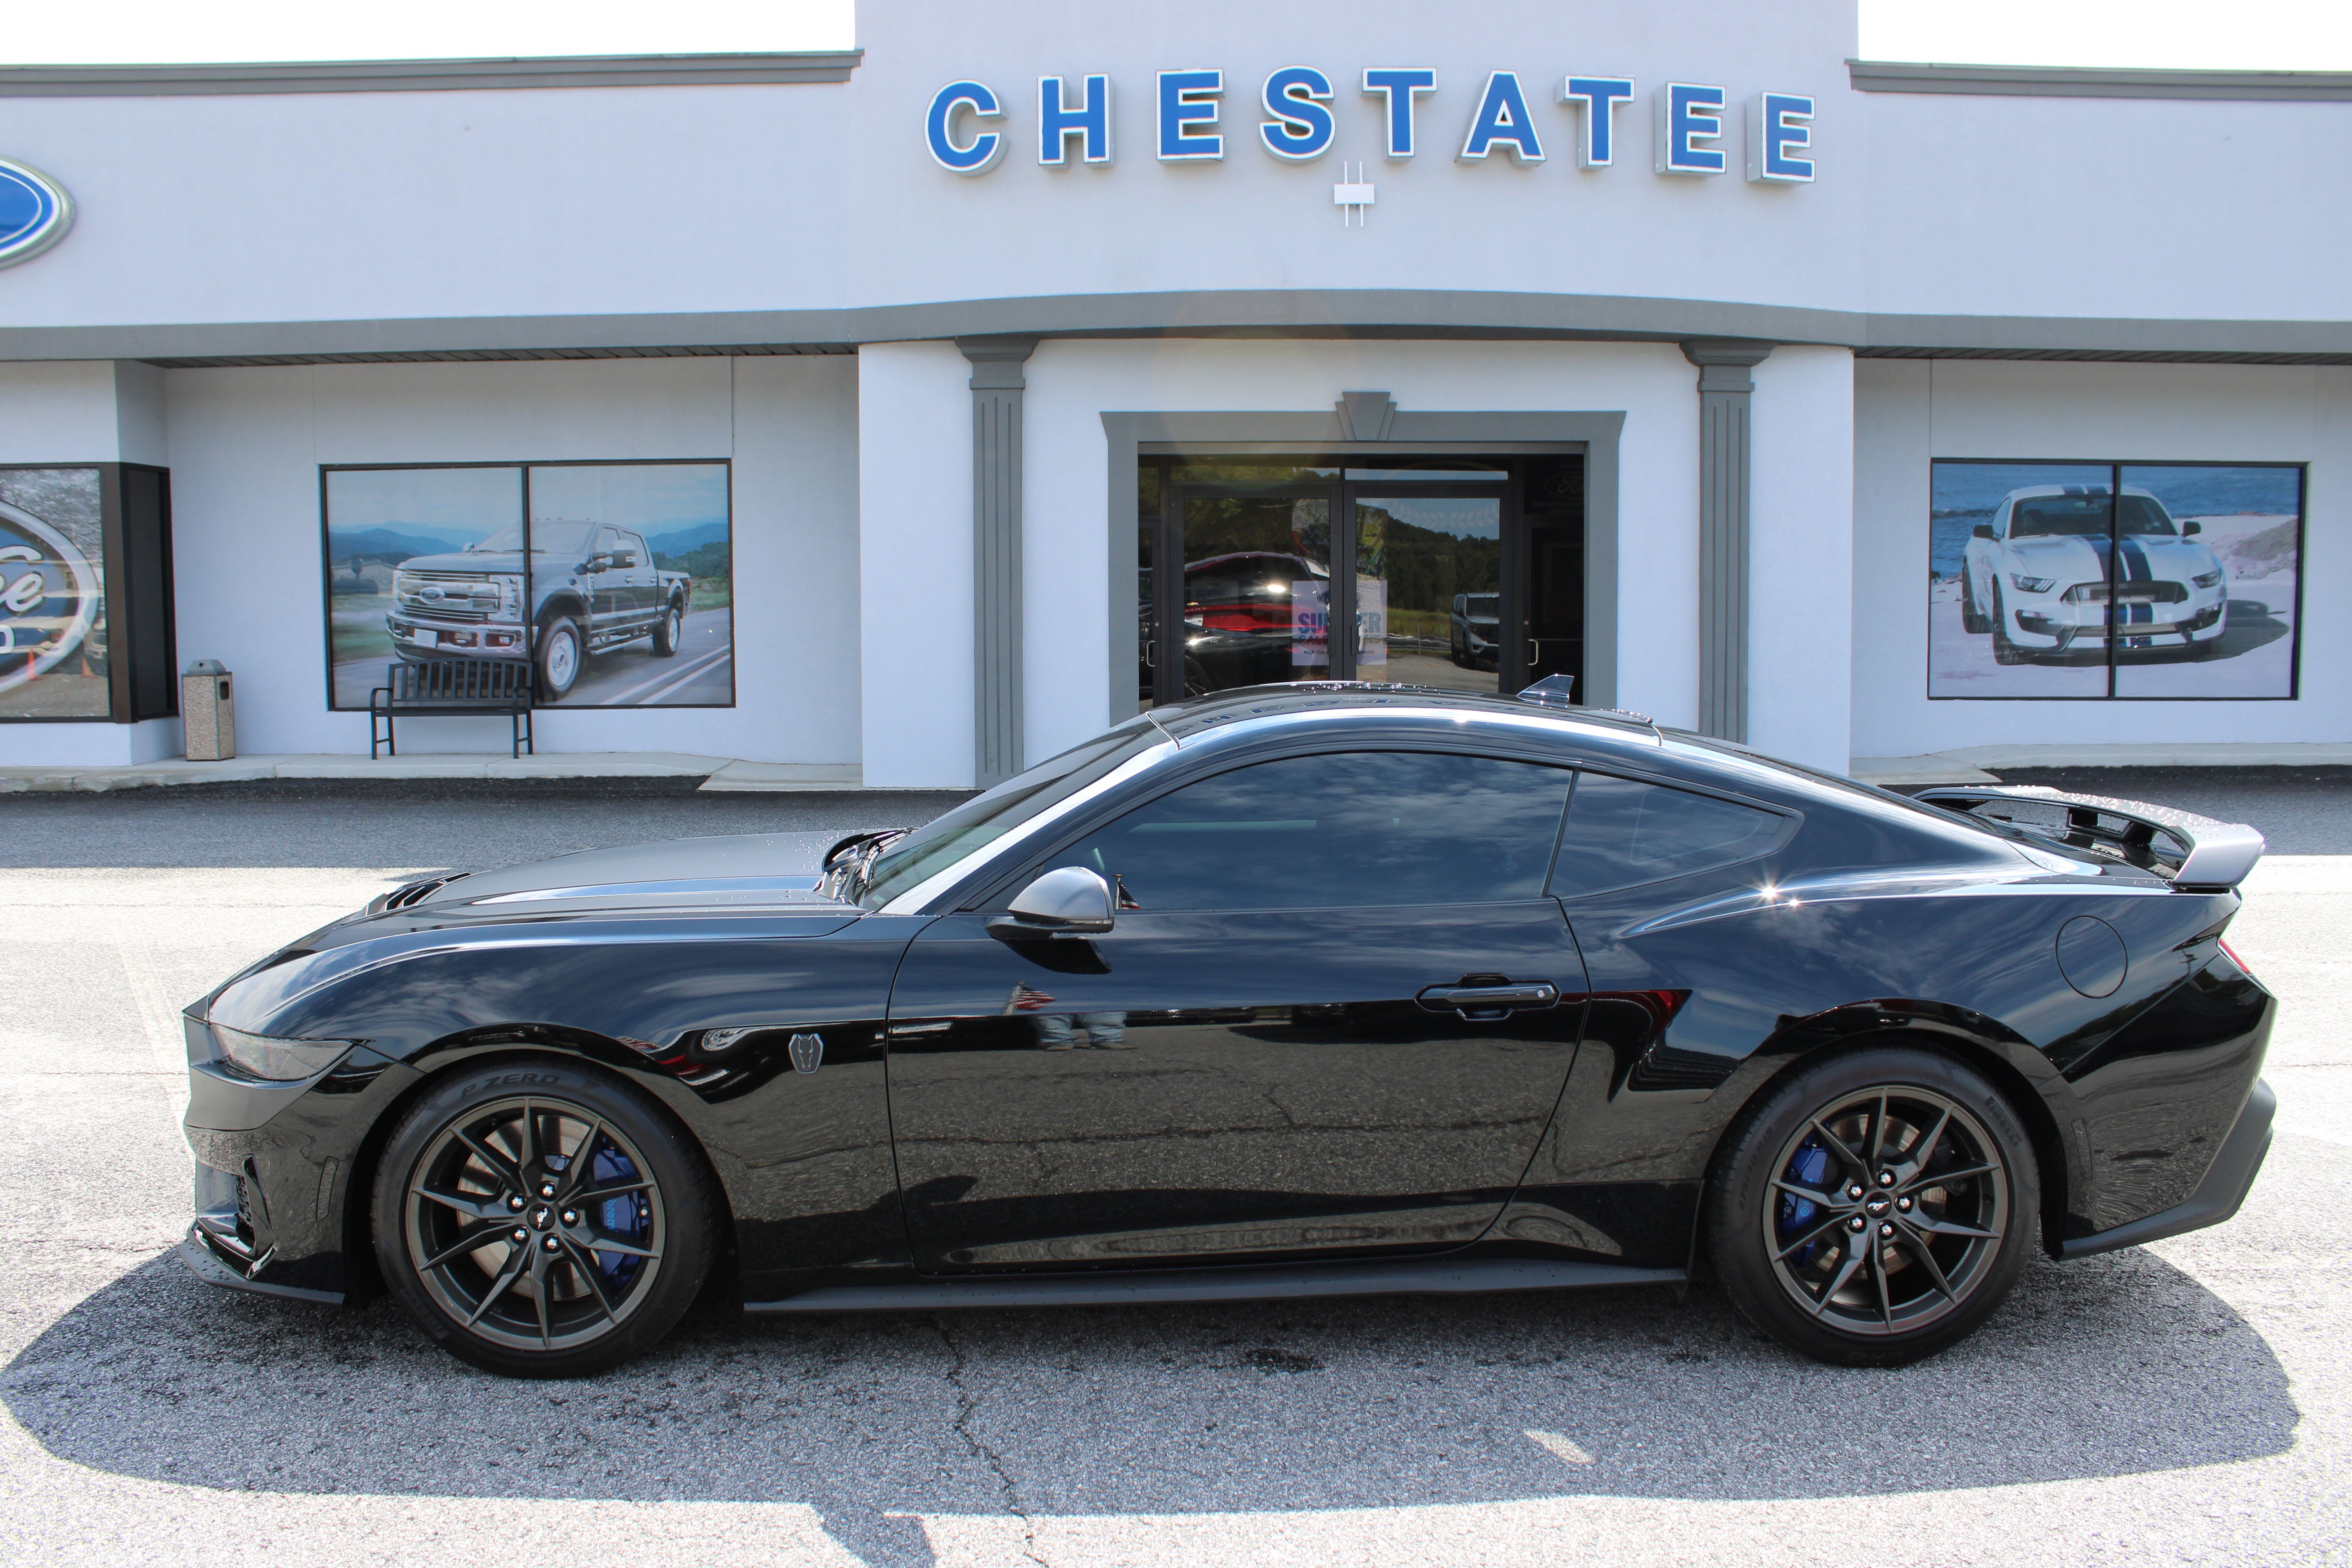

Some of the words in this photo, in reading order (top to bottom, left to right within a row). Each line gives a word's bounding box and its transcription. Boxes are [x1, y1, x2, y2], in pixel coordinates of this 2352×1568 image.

[924, 65, 1816, 185] CHESTATEE
[461, 1083, 477, 1098] P
[483, 1073, 561, 1089] ZERO
